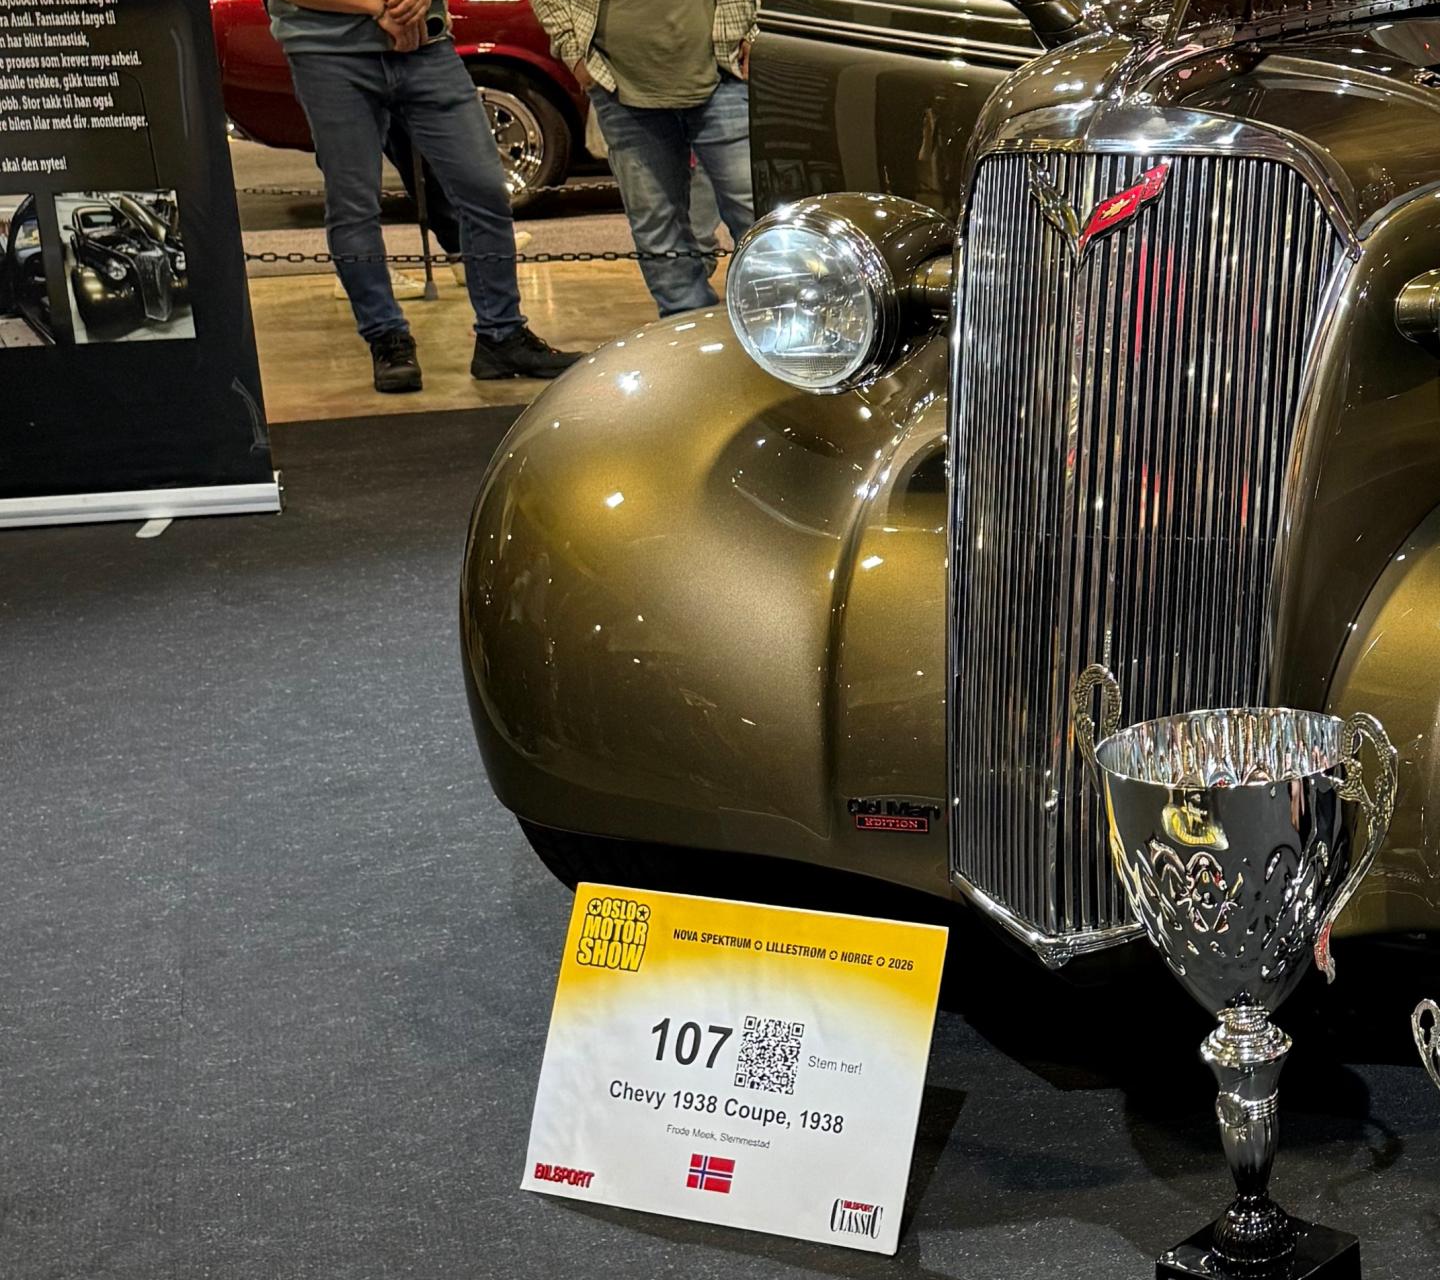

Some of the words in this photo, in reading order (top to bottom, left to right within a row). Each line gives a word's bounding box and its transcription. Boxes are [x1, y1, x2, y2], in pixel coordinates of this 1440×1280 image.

[11, 11, 34, 27] Audi.
[35, 11, 80, 27] Fantastisk
[81, 10, 105, 29] farge
[105, 10, 116, 25] til
[6, 33, 23, 48] har
[23, 33, 42, 48] blitt
[43, 32, 90, 48] fantastisk,
[6, 56, 40, 72] prosess
[40, 56, 60, 68] som
[60, 53, 90, 68] krever
[91, 55, 110, 70] mye
[111, 51, 142, 66] arbeid.
[26, 74, 62, 90] trekkes,
[63, 72, 83, 92] gikk
[83, 74, 109, 88] turen
[109, 72, 120, 87] til
[22, 95, 41, 110] Stor
[41, 94, 62, 109] takk
[62, 93, 73, 108] til
[73, 93, 92, 108] han
[92, 91, 114, 111] også
[8, 116, 32, 131] bilen
[32, 115, 50, 130] klar
[51, 114, 72, 129] med
[72, 113, 90, 129] div.
[91, 112, 149, 130] monteringer.
[2, 157, 20, 172] skal
[21, 156, 39, 172] den
[40, 155, 67, 174] nytes!
[864, 816, 919, 829] EDITION
[600, 897, 639, 921] OSLO
[582, 913, 649, 946] MOTOR
[576, 937, 646, 972] SHOW
[673, 928, 698, 942] NOVA
[700, 932, 751, 949] SPEKTRUM
[765, 940, 827, 959] LILLESTRØM
[840, 950, 873, 966] NORGE
[888, 957, 914, 971] 2026
[651, 1017, 734, 1069] 107
[807, 1055, 838, 1071] Stem
[840, 1061, 863, 1075] her!
[609, 1079, 666, 1110] Chevy
[672, 1090, 718, 1114] 1938
[724, 1097, 792, 1129] Coupe,
[800, 1110, 844, 1134] 1938
[534, 1162, 595, 1189] BILSPORT
